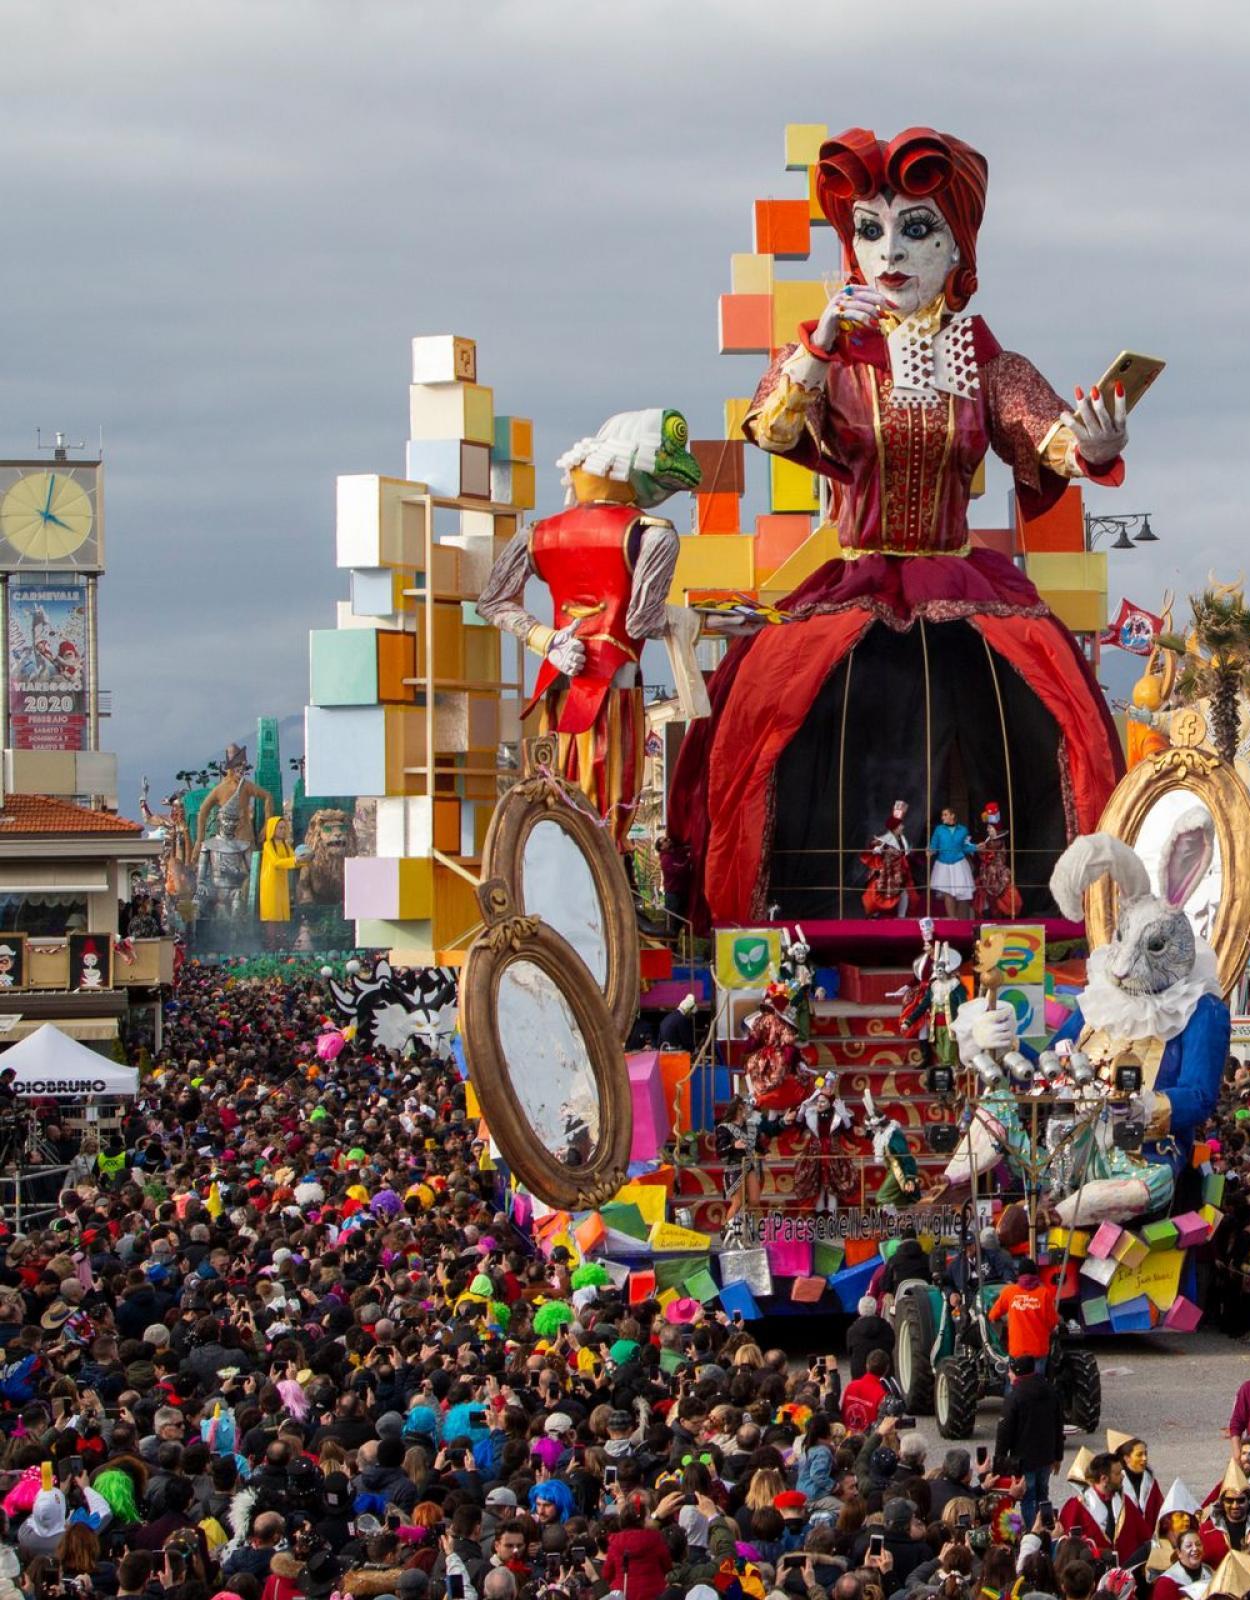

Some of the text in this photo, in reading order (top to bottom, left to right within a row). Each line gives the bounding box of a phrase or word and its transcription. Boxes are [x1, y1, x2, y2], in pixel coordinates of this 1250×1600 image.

[13, 591, 80, 600] CARNEVALE
[14, 681, 82, 692] VIAREGGIO
[24, 696, 73, 712] 2020
